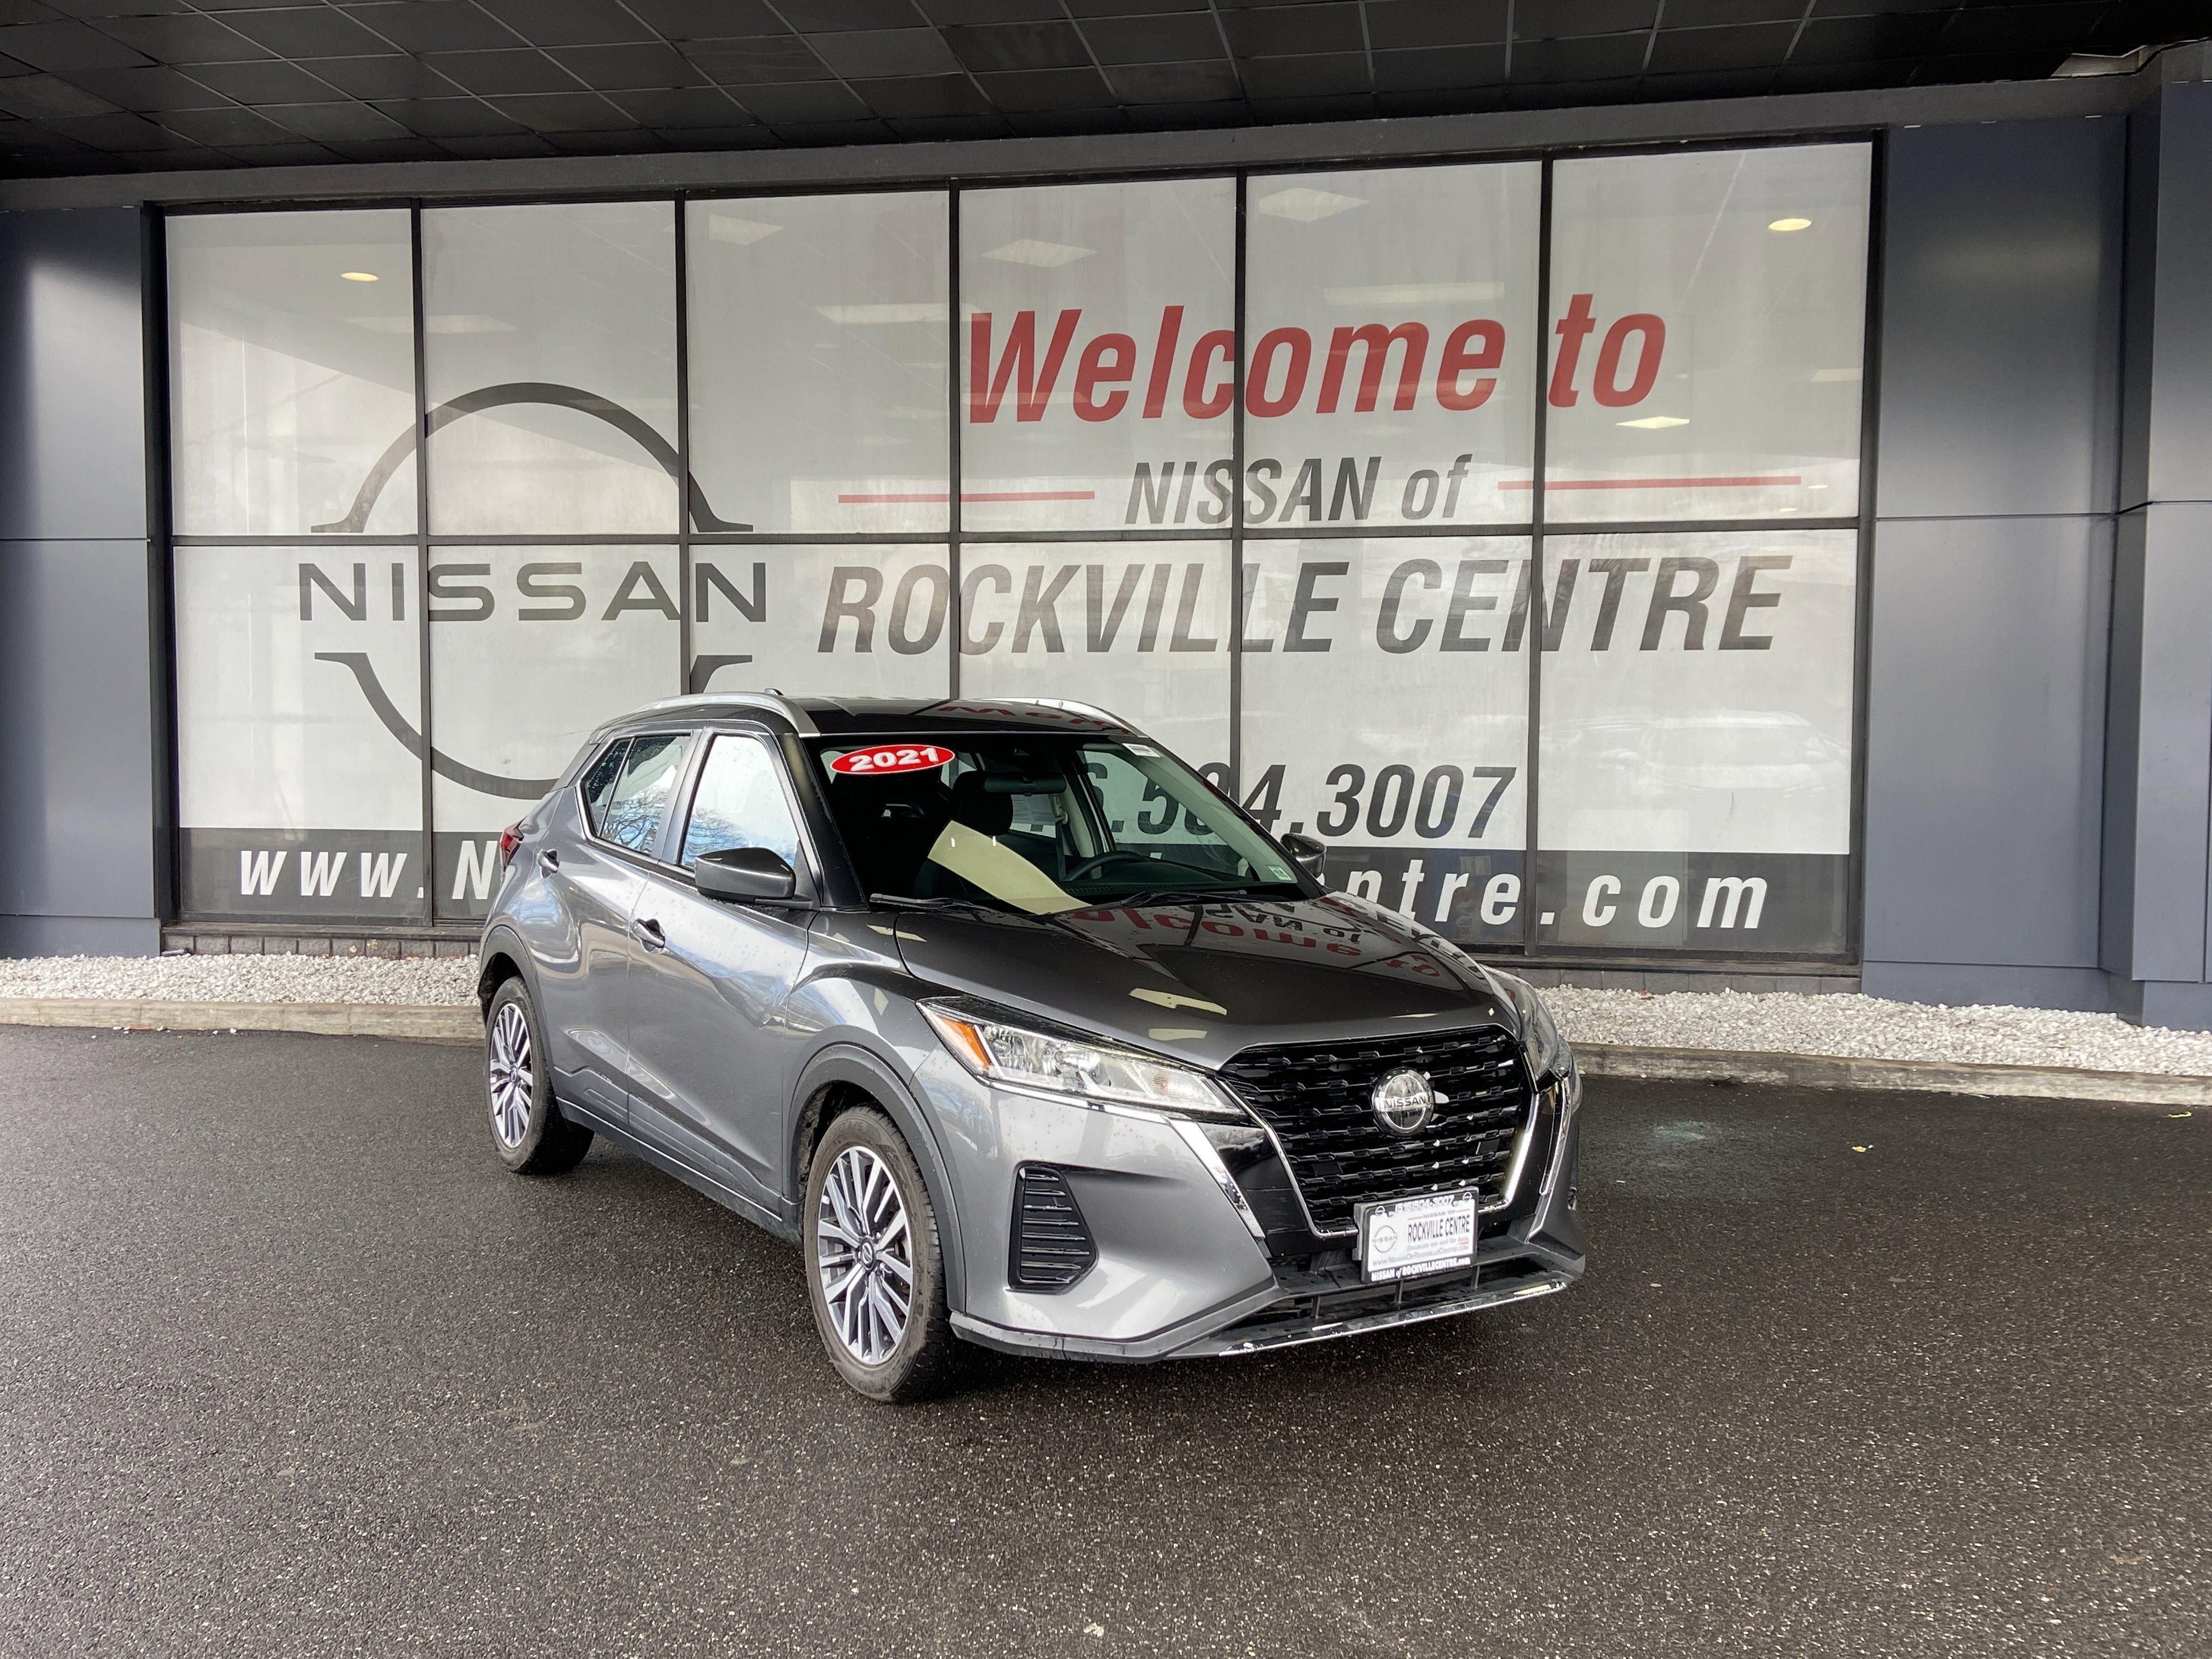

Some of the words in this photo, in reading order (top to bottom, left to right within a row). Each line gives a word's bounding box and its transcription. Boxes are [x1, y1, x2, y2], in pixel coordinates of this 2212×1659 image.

[970, 310, 1504, 422] Welcome
[1548, 295, 1664, 410] to
[1124, 456, 1383, 526] NISSAN
[1400, 453, 1473, 522] of
[299, 562, 766, 623] NISSAN
[817, 563, 1350, 654] ROCKVILLE
[1376, 555, 1794, 652] CENTRE
[849, 747, 940, 772] 2021
[1315, 856, 1768, 929] ntre.com
[1384, 1096, 1427, 1109] NISSAN
[1408, 1218, 1443, 1243] ROCKVILLE
[1445, 1214, 1470, 1236] CENTRE
[1423, 1211, 1446, 1219] NISSAN
[1372, 1234, 1398, 1243] NISSAN
[1372, 1268, 1395, 1281] NISSAN
[1396, 1268, 1402, 1278] of
